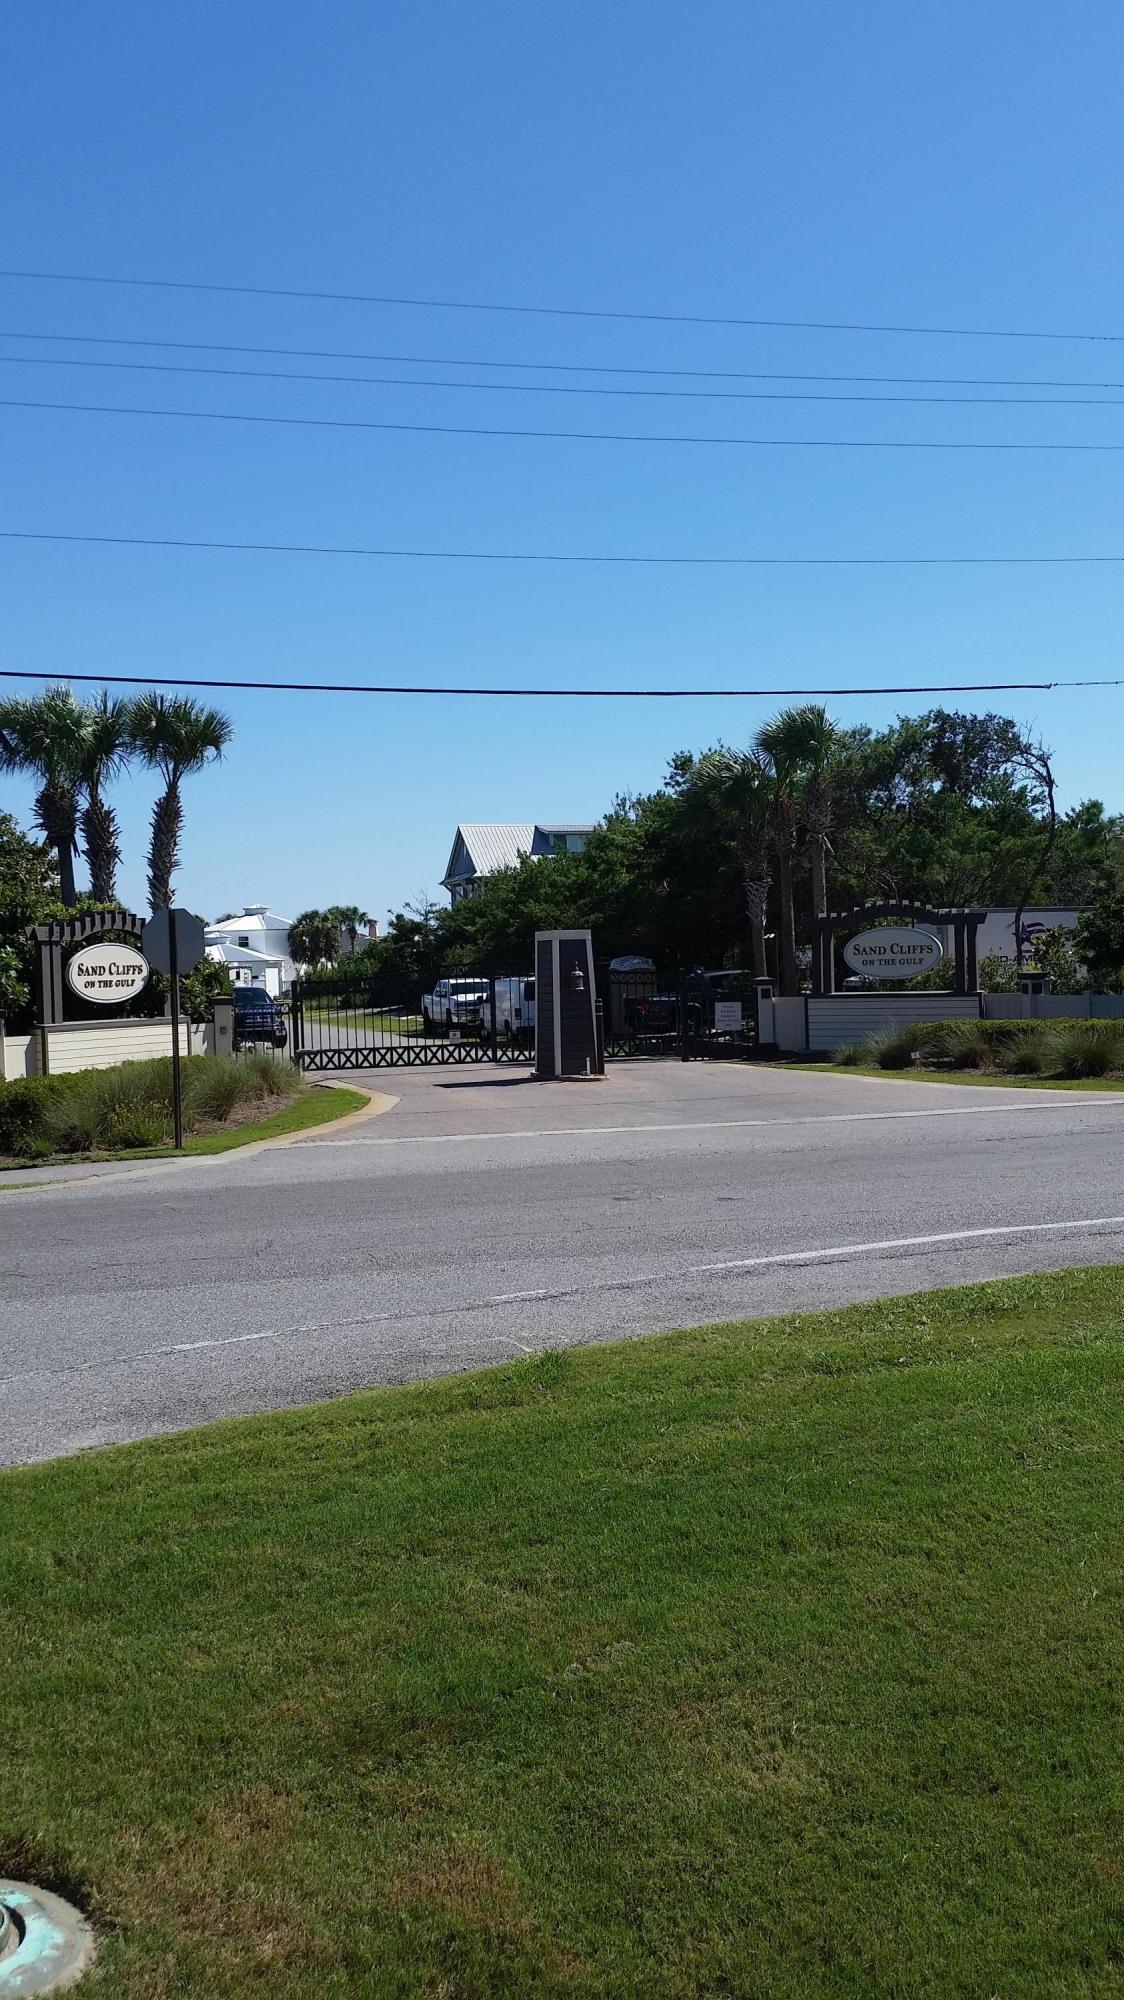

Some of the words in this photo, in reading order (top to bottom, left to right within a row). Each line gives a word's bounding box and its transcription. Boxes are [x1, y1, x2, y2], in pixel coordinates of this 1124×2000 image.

[853, 943, 887, 956] SAND
[890, 942, 933, 954] CLIFFS
[877, 958, 897, 966] THE
[77, 962, 106, 976] SAND
[109, 962, 143, 975] CLIFFS
[84, 980, 96, 988] ON
[98, 980, 113, 988] THE
[115, 979, 136, 987] GULF
